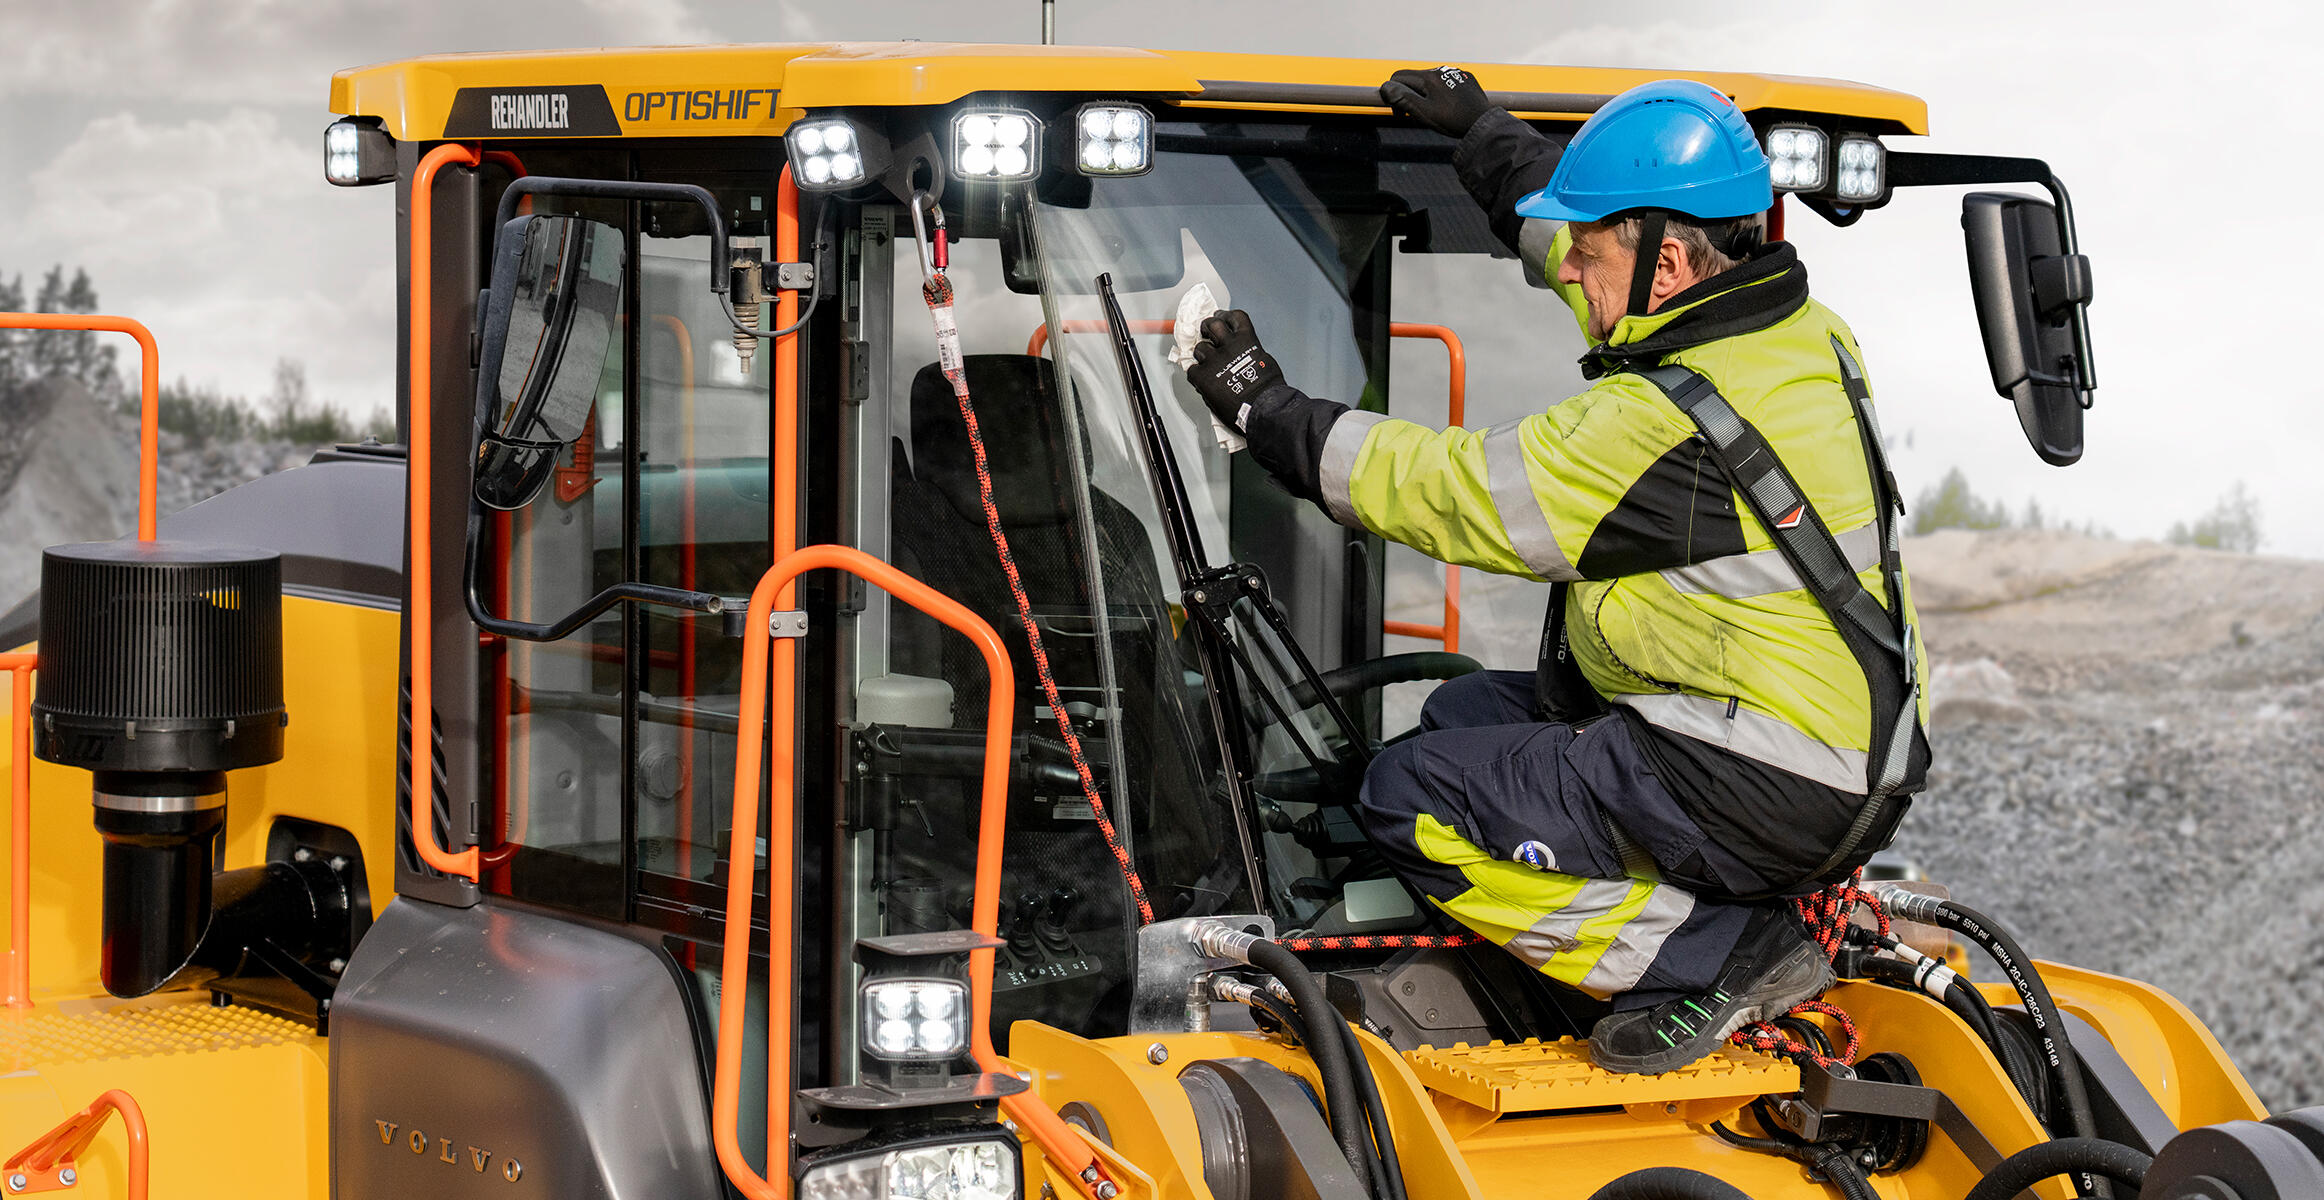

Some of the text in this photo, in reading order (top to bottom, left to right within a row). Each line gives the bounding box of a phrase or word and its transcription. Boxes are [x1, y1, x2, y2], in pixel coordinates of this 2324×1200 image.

[491, 94, 569, 129] REHANDLER
[624, 89, 781, 122] OPTISHIFT
[1948, 909, 1961, 922] bar
[1962, 918, 1979, 935] 5510
[1991, 942, 2012, 969] MSHA
[2043, 1037, 2060, 1067] 43148
[375, 1119, 523, 1183] VOLVO
